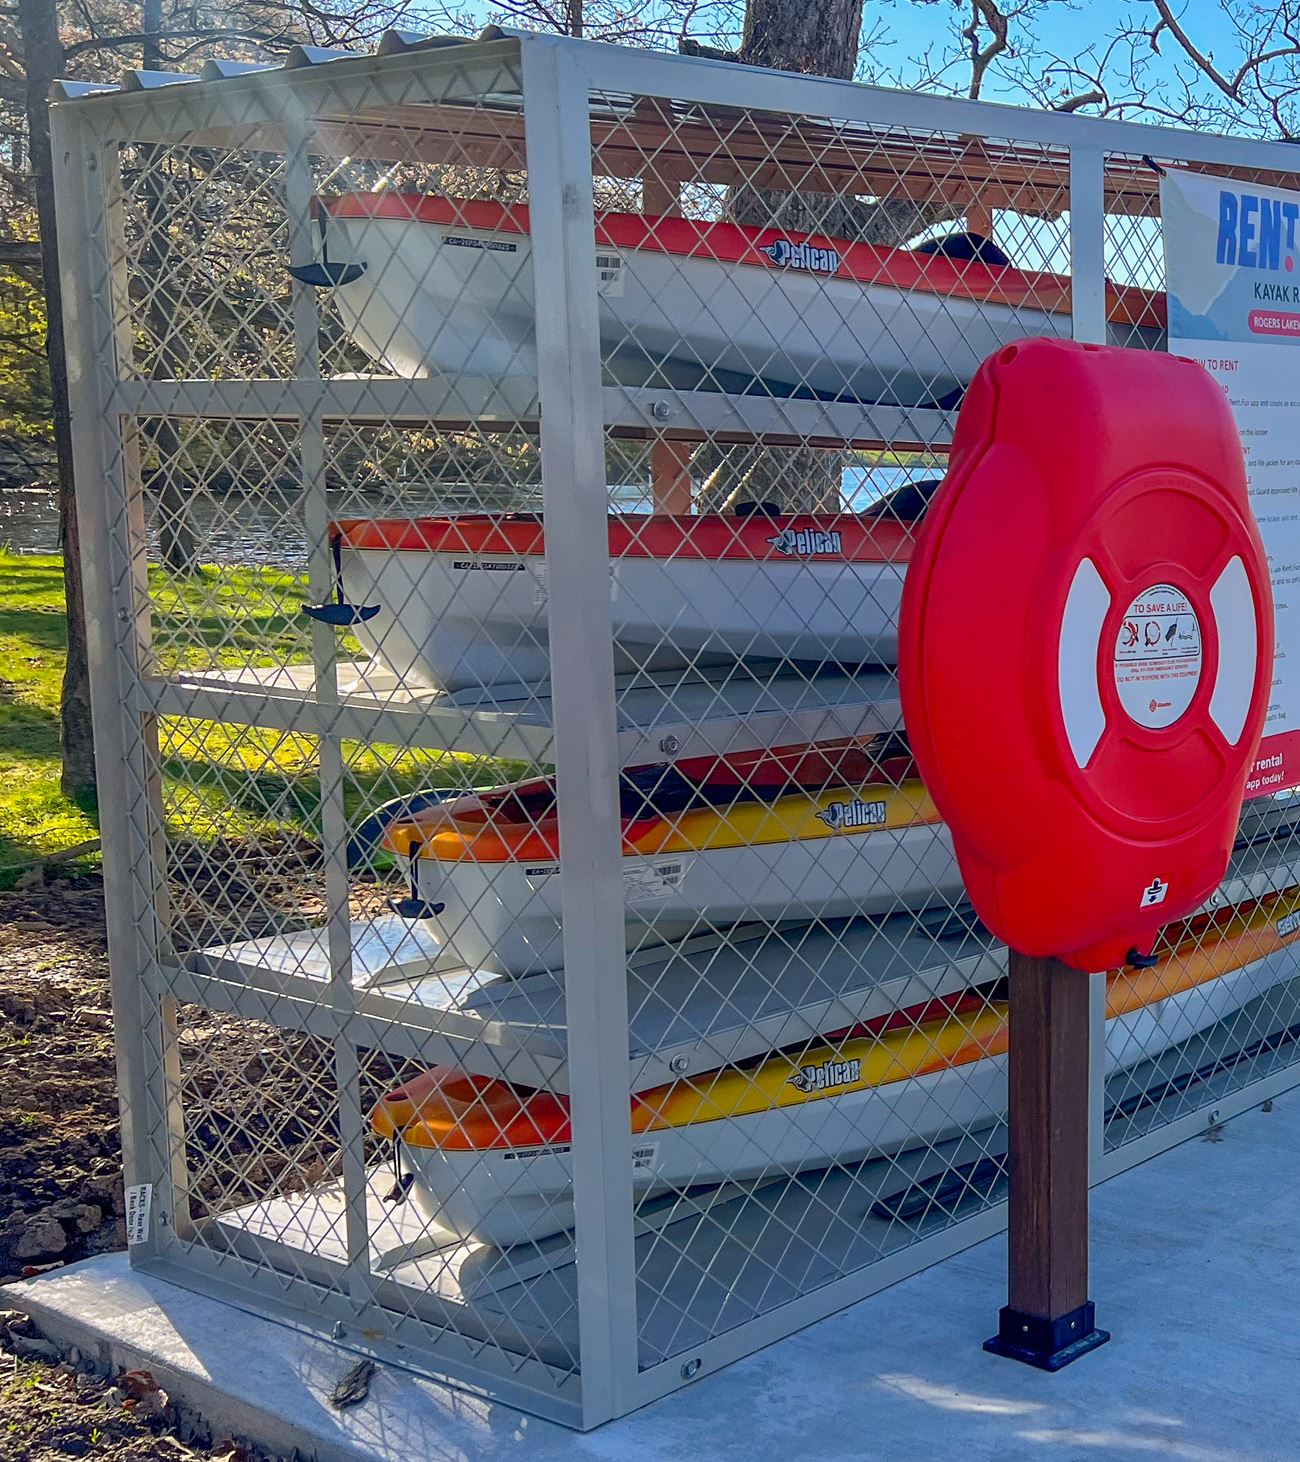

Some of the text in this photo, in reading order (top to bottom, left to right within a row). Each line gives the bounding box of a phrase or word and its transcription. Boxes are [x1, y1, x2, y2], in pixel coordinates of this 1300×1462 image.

[772, 238, 838, 273] Pelican
[1254, 282, 1290, 303] KAYAK
[1253, 316, 1280, 329] ROGERS
[1208, 359, 1218, 370] TO
[1219, 359, 1239, 371] RENT
[780, 528, 841, 555] Pelican
[1134, 602, 1188, 613] TO SAVE A LIFE!
[1256, 752, 1283, 771] rental
[1246, 770, 1285, 790] app today!
[828, 799, 887, 829] Pelican
[799, 1059, 860, 1093] Pelican
[139, 1186, 147, 1208] RACKS
